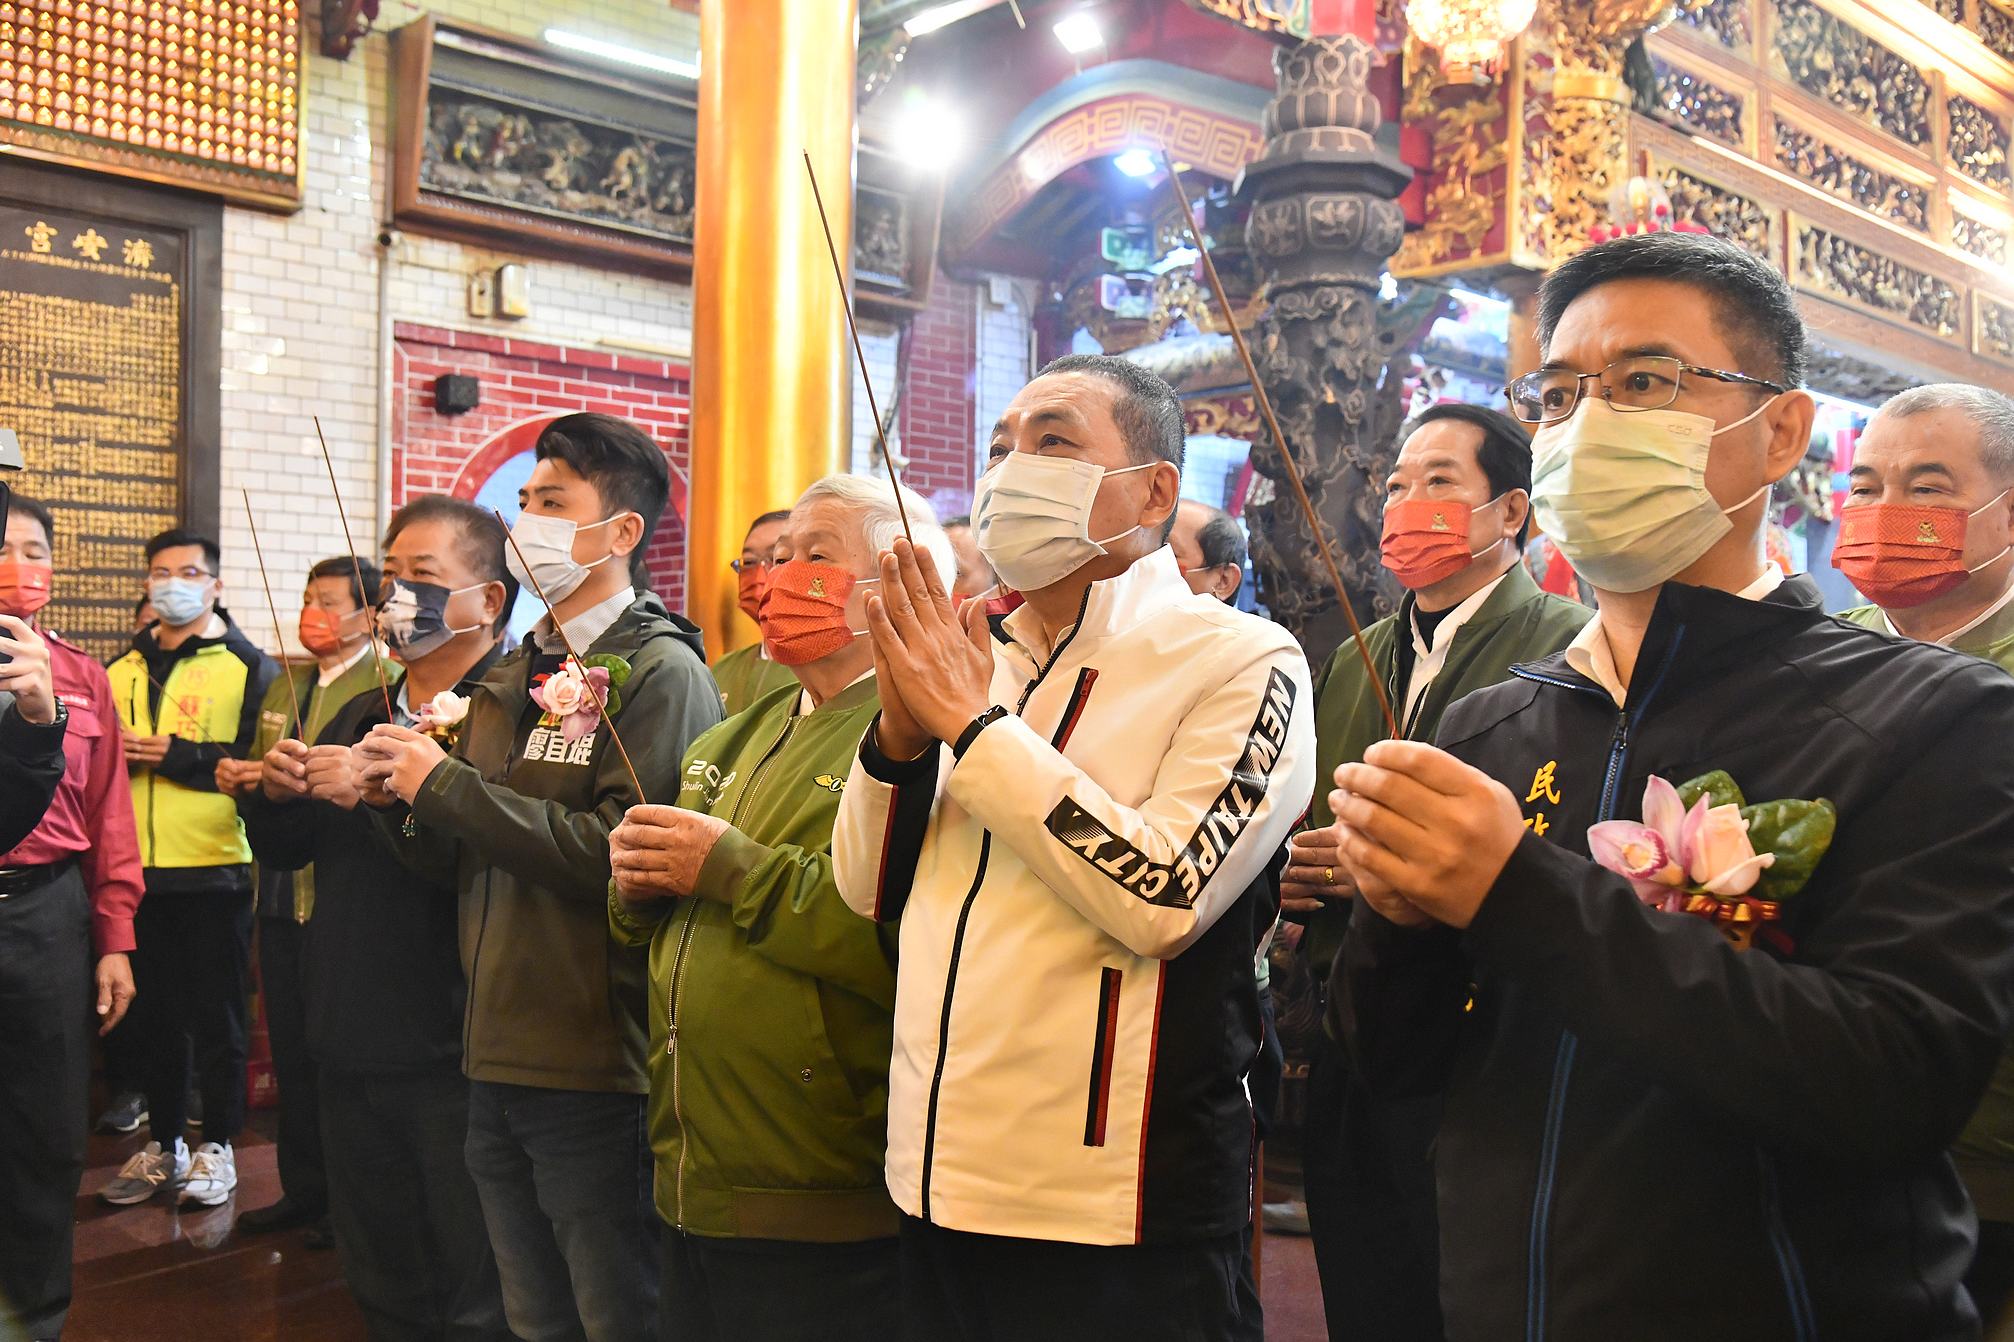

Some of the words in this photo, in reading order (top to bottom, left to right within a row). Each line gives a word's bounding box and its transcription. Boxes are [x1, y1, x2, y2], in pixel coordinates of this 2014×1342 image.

[1247, 674, 1292, 784] NEW
[1060, 827, 1169, 898] CITY
[1172, 782, 1253, 902] TAIPE
